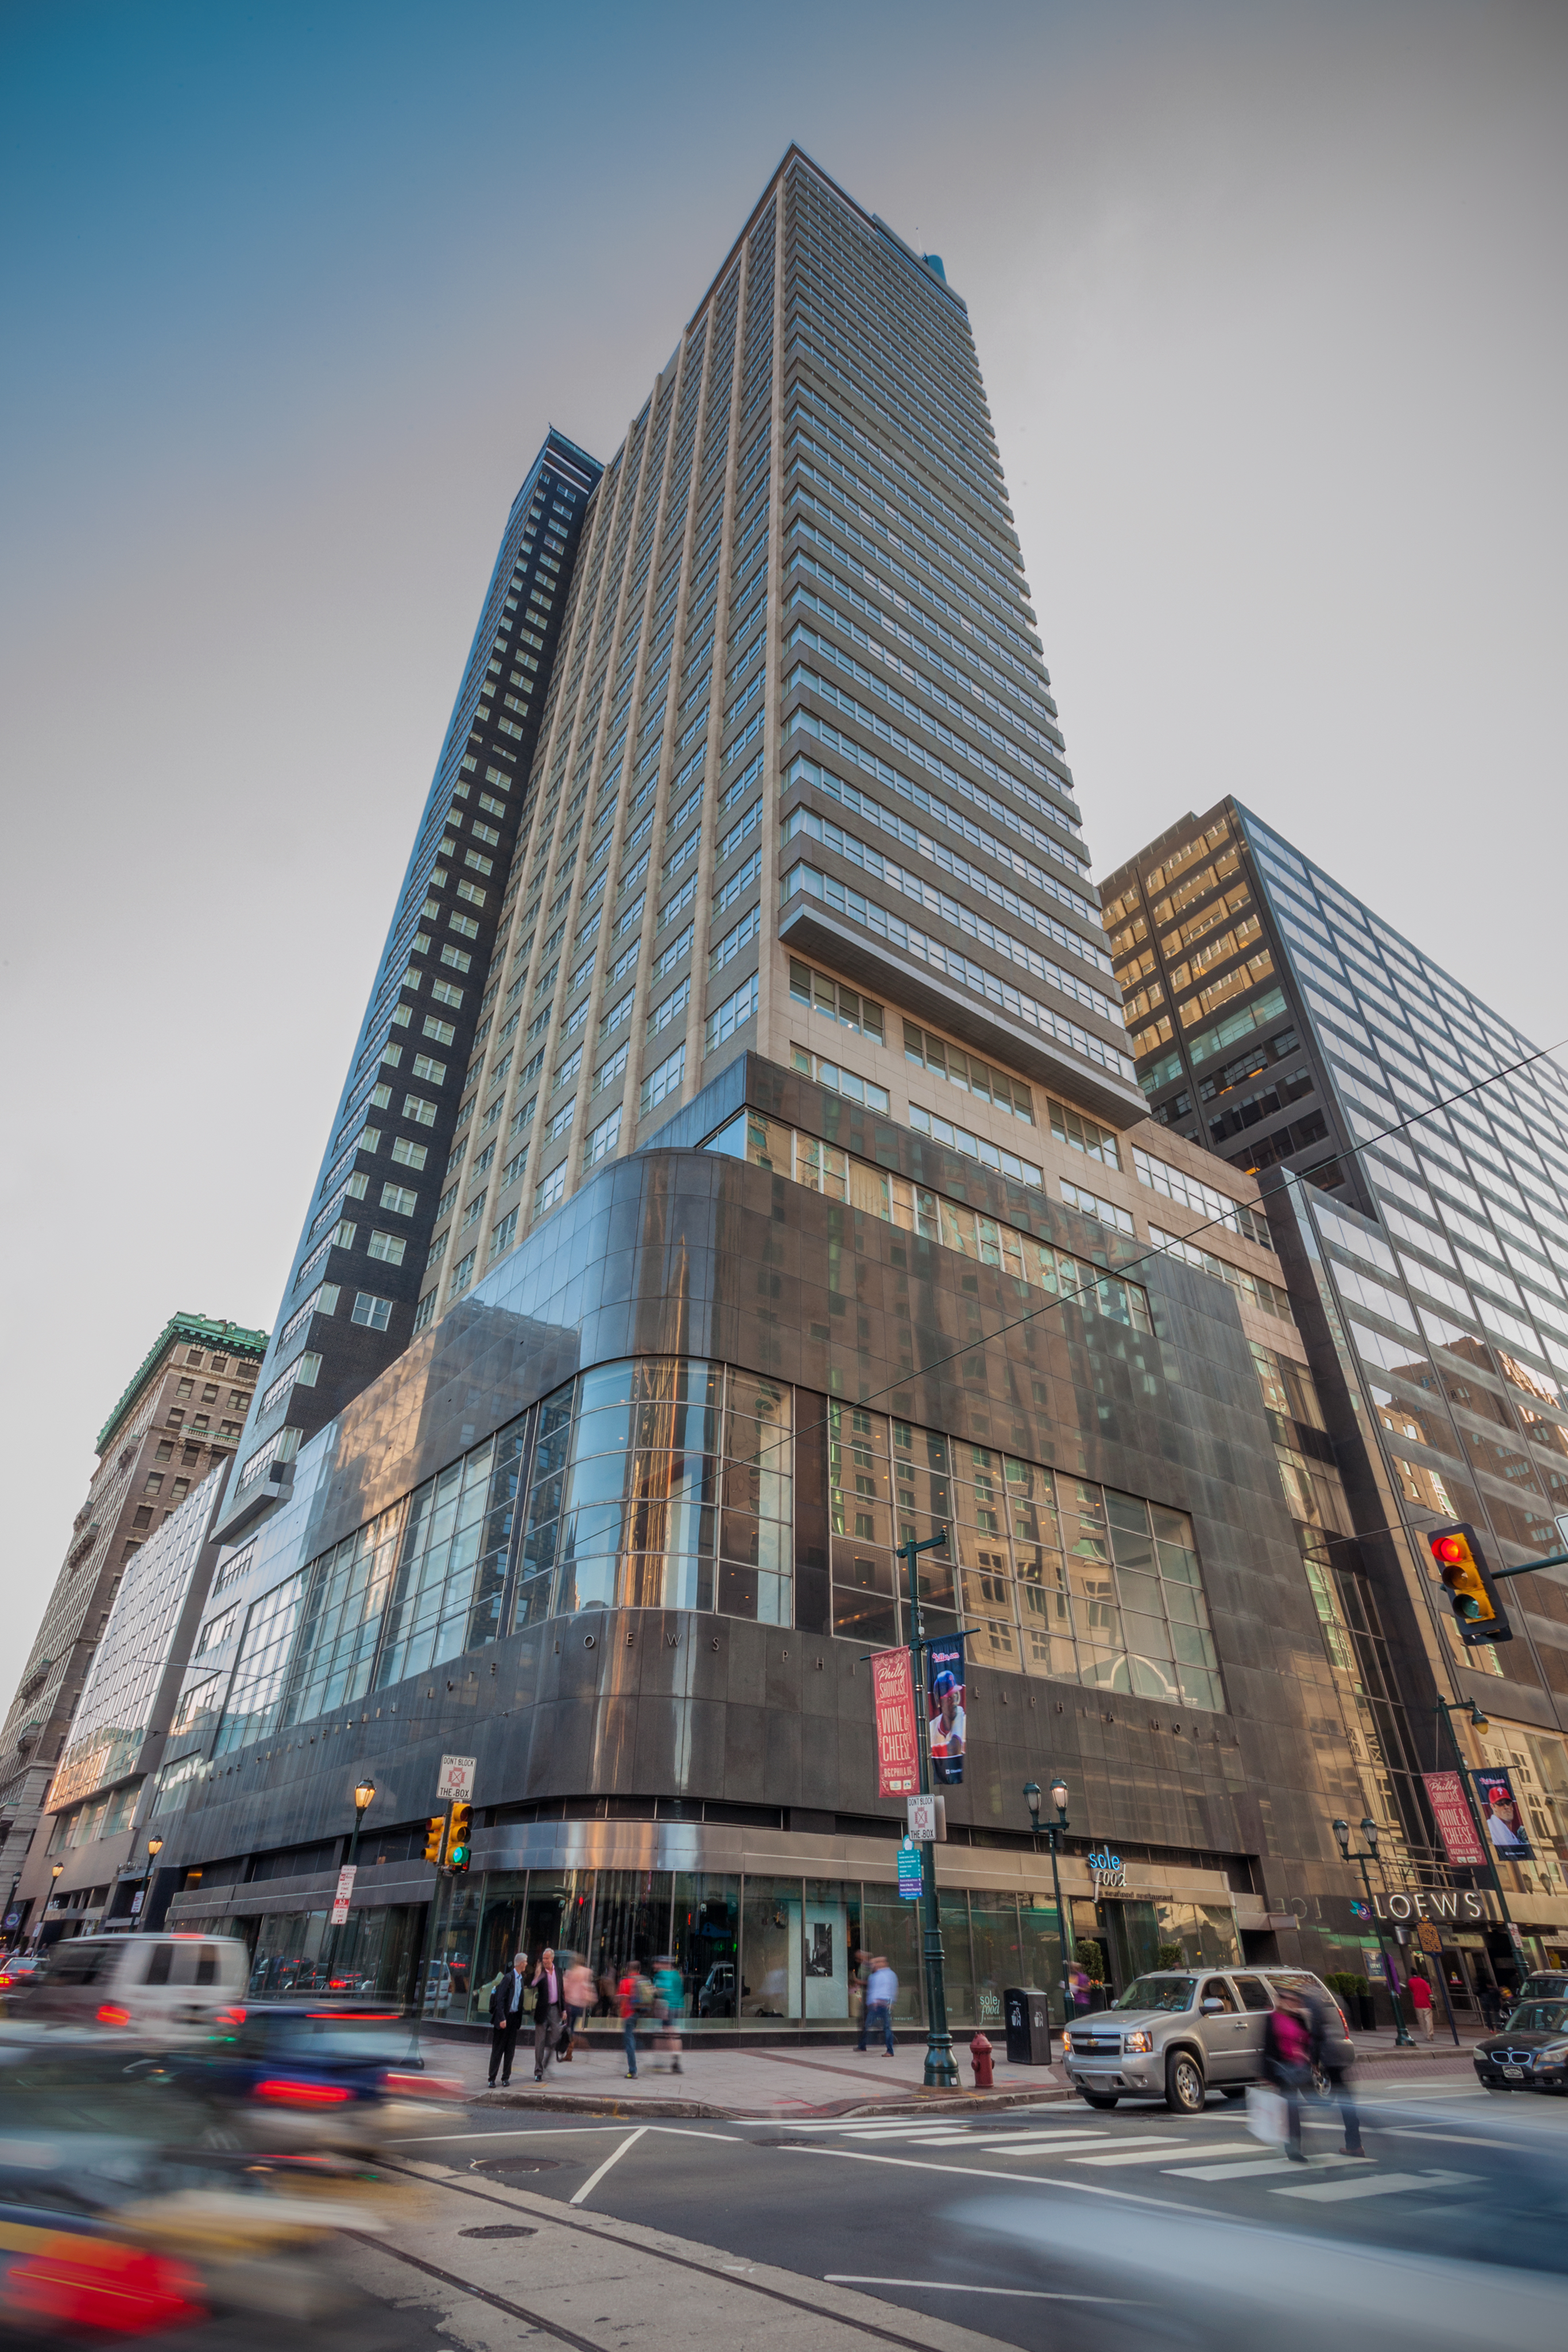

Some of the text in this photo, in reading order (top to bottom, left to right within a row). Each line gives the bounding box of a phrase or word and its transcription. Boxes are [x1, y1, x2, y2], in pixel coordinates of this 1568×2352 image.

[878, 1662, 906, 1683] Philly
[880, 1677, 906, 1699] SHOWCASE
[881, 1705, 904, 1734] WINE
[882, 1733, 911, 1761] CHEESE
[458, 1759, 474, 1767] BLOCK
[440, 1788, 469, 1797] THE BOX
[1430, 1780, 1458, 1794] Philly
[920, 1797, 933, 1805] BLOCK
[1433, 1791, 1461, 1803] SHOWCASE
[1437, 1808, 1469, 1826] WINE &
[911, 1829, 934, 1839] THE BOX
[1443, 1826, 1475, 1844] CHEESE
[1089, 1846, 1120, 1870] sole
[1092, 1863, 1127, 1903] food
[1105, 1890, 1135, 1898] seafood
[1136, 1892, 1174, 1902] restaurant
[1373, 1891, 1482, 1919] LOEWS
[979, 1990, 998, 2005] sole
[979, 1999, 1000, 2025] food
